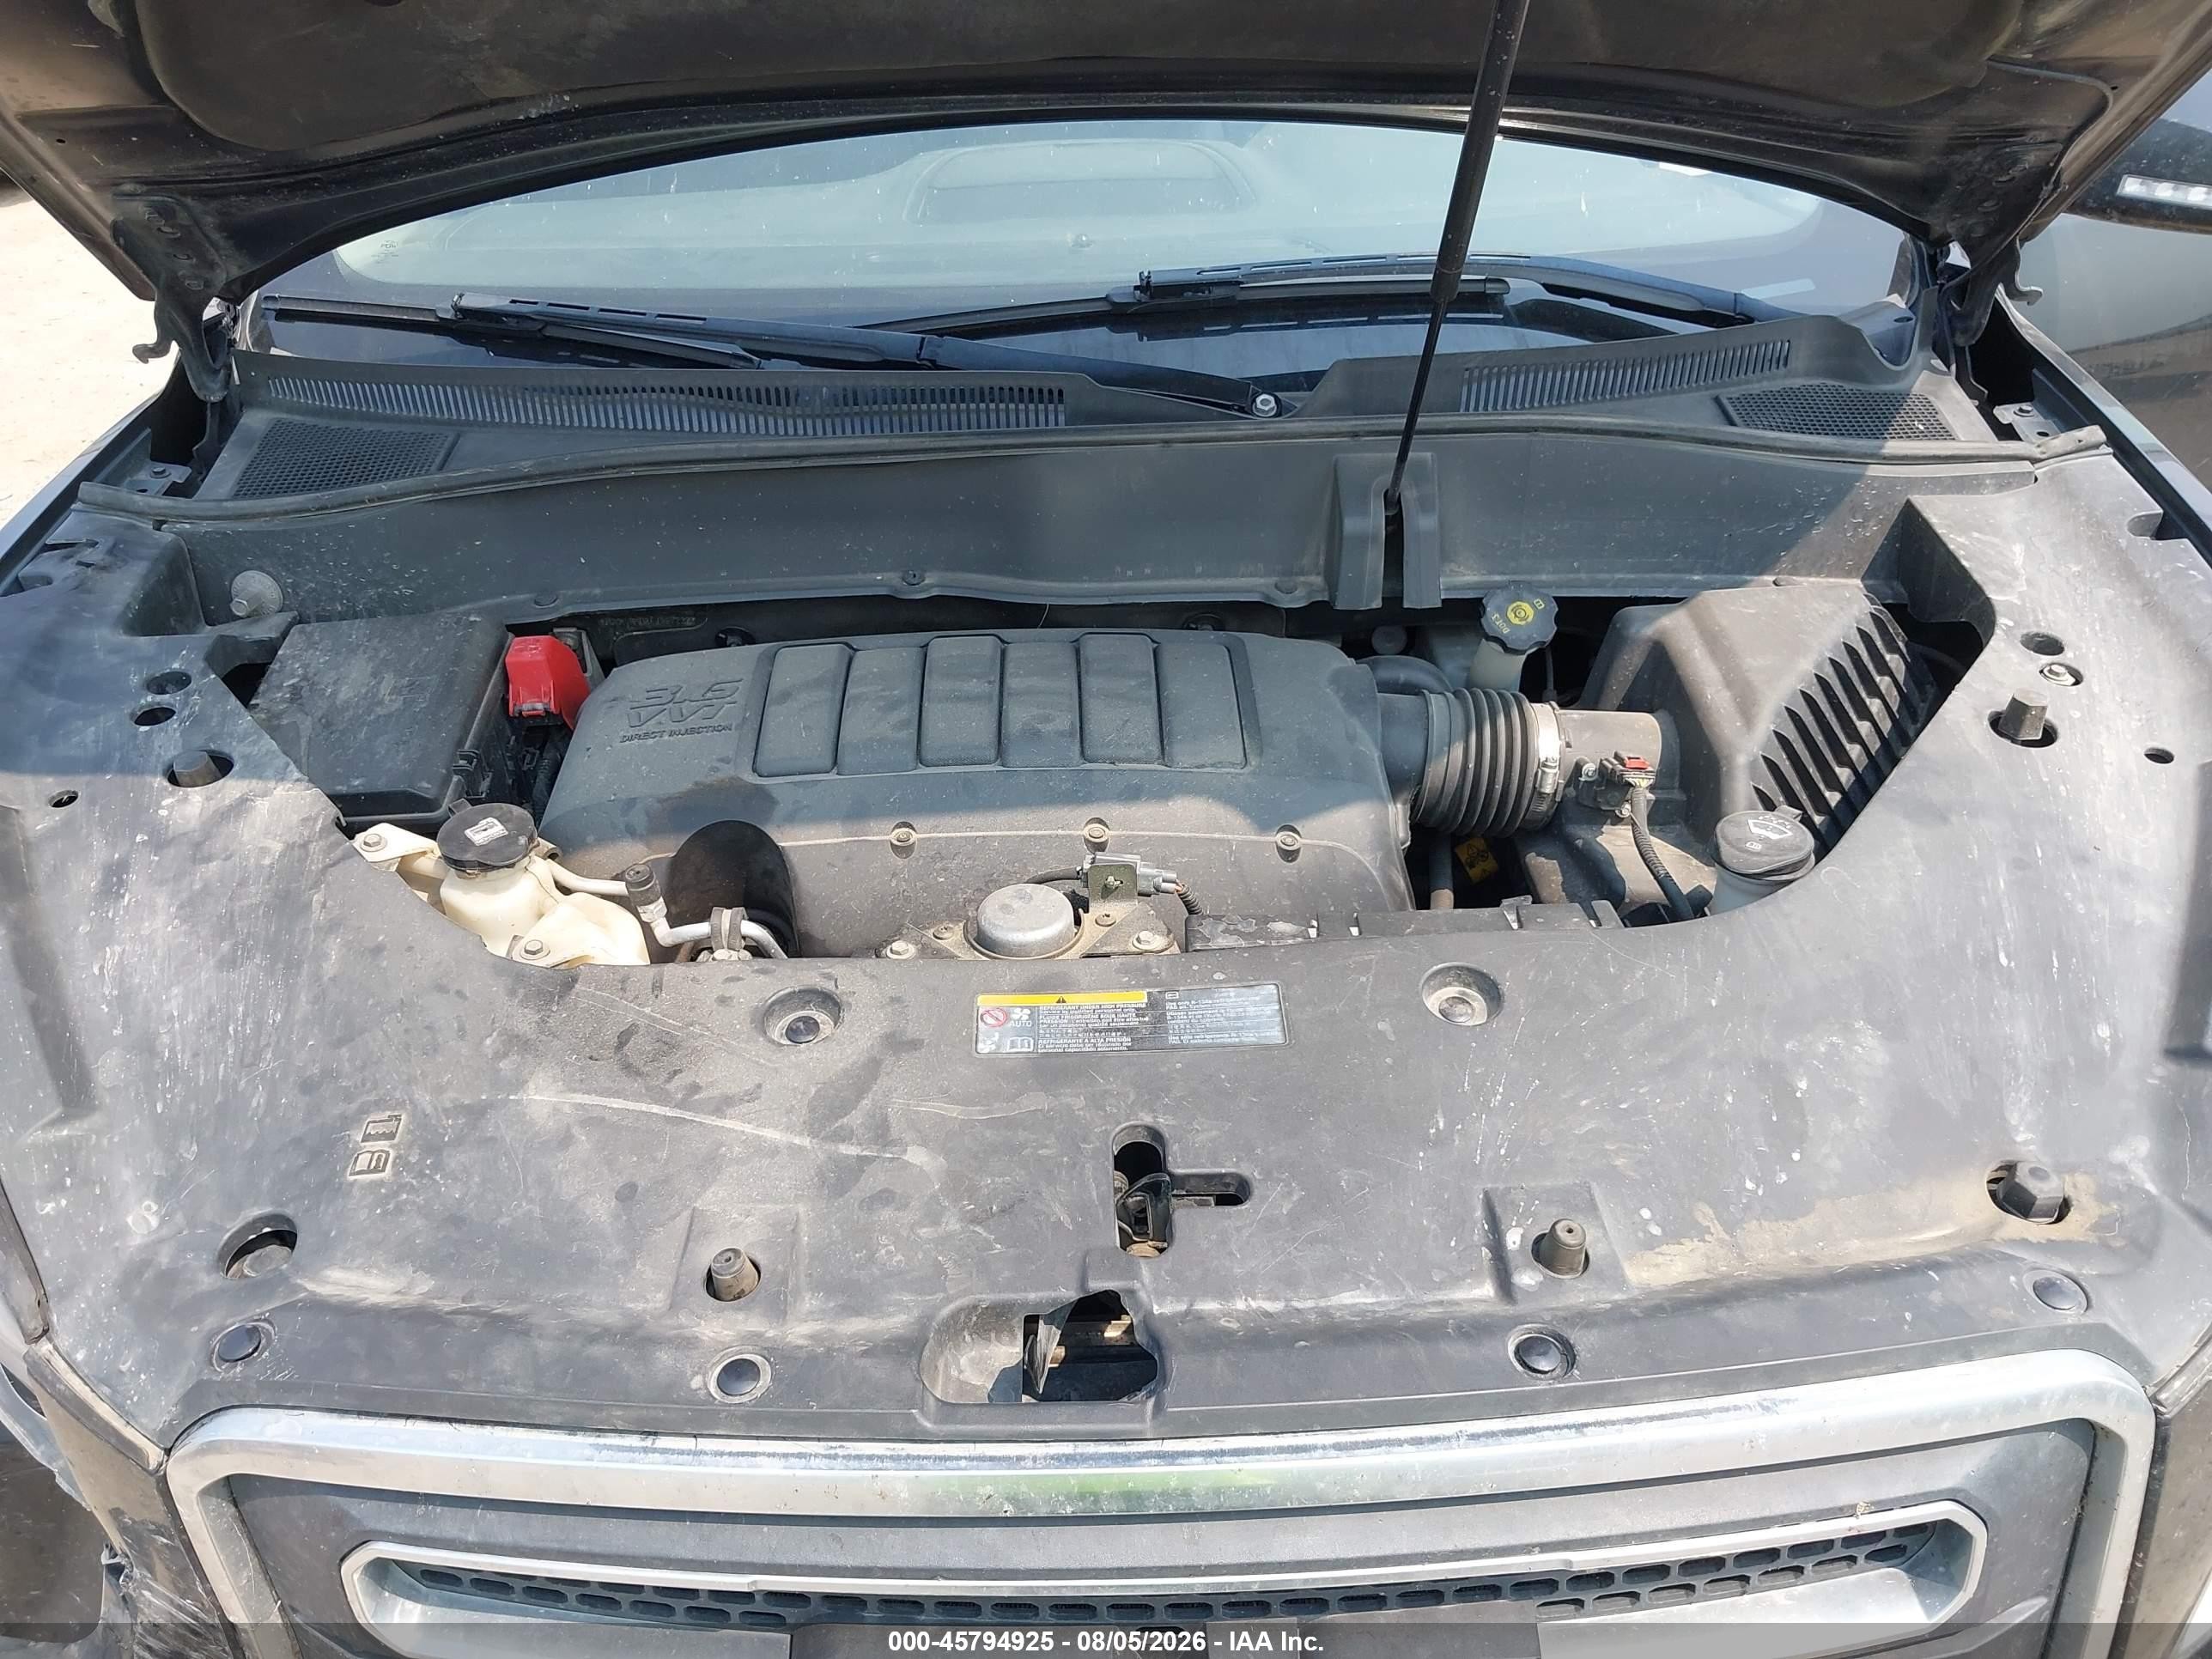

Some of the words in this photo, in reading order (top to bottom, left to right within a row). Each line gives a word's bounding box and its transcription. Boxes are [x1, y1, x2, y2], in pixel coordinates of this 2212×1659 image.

[630, 678, 744, 710] 3.6
[627, 701, 738, 728] VVT
[619, 729, 666, 744] DIRECT
[668, 724, 732, 737] INJECTION
